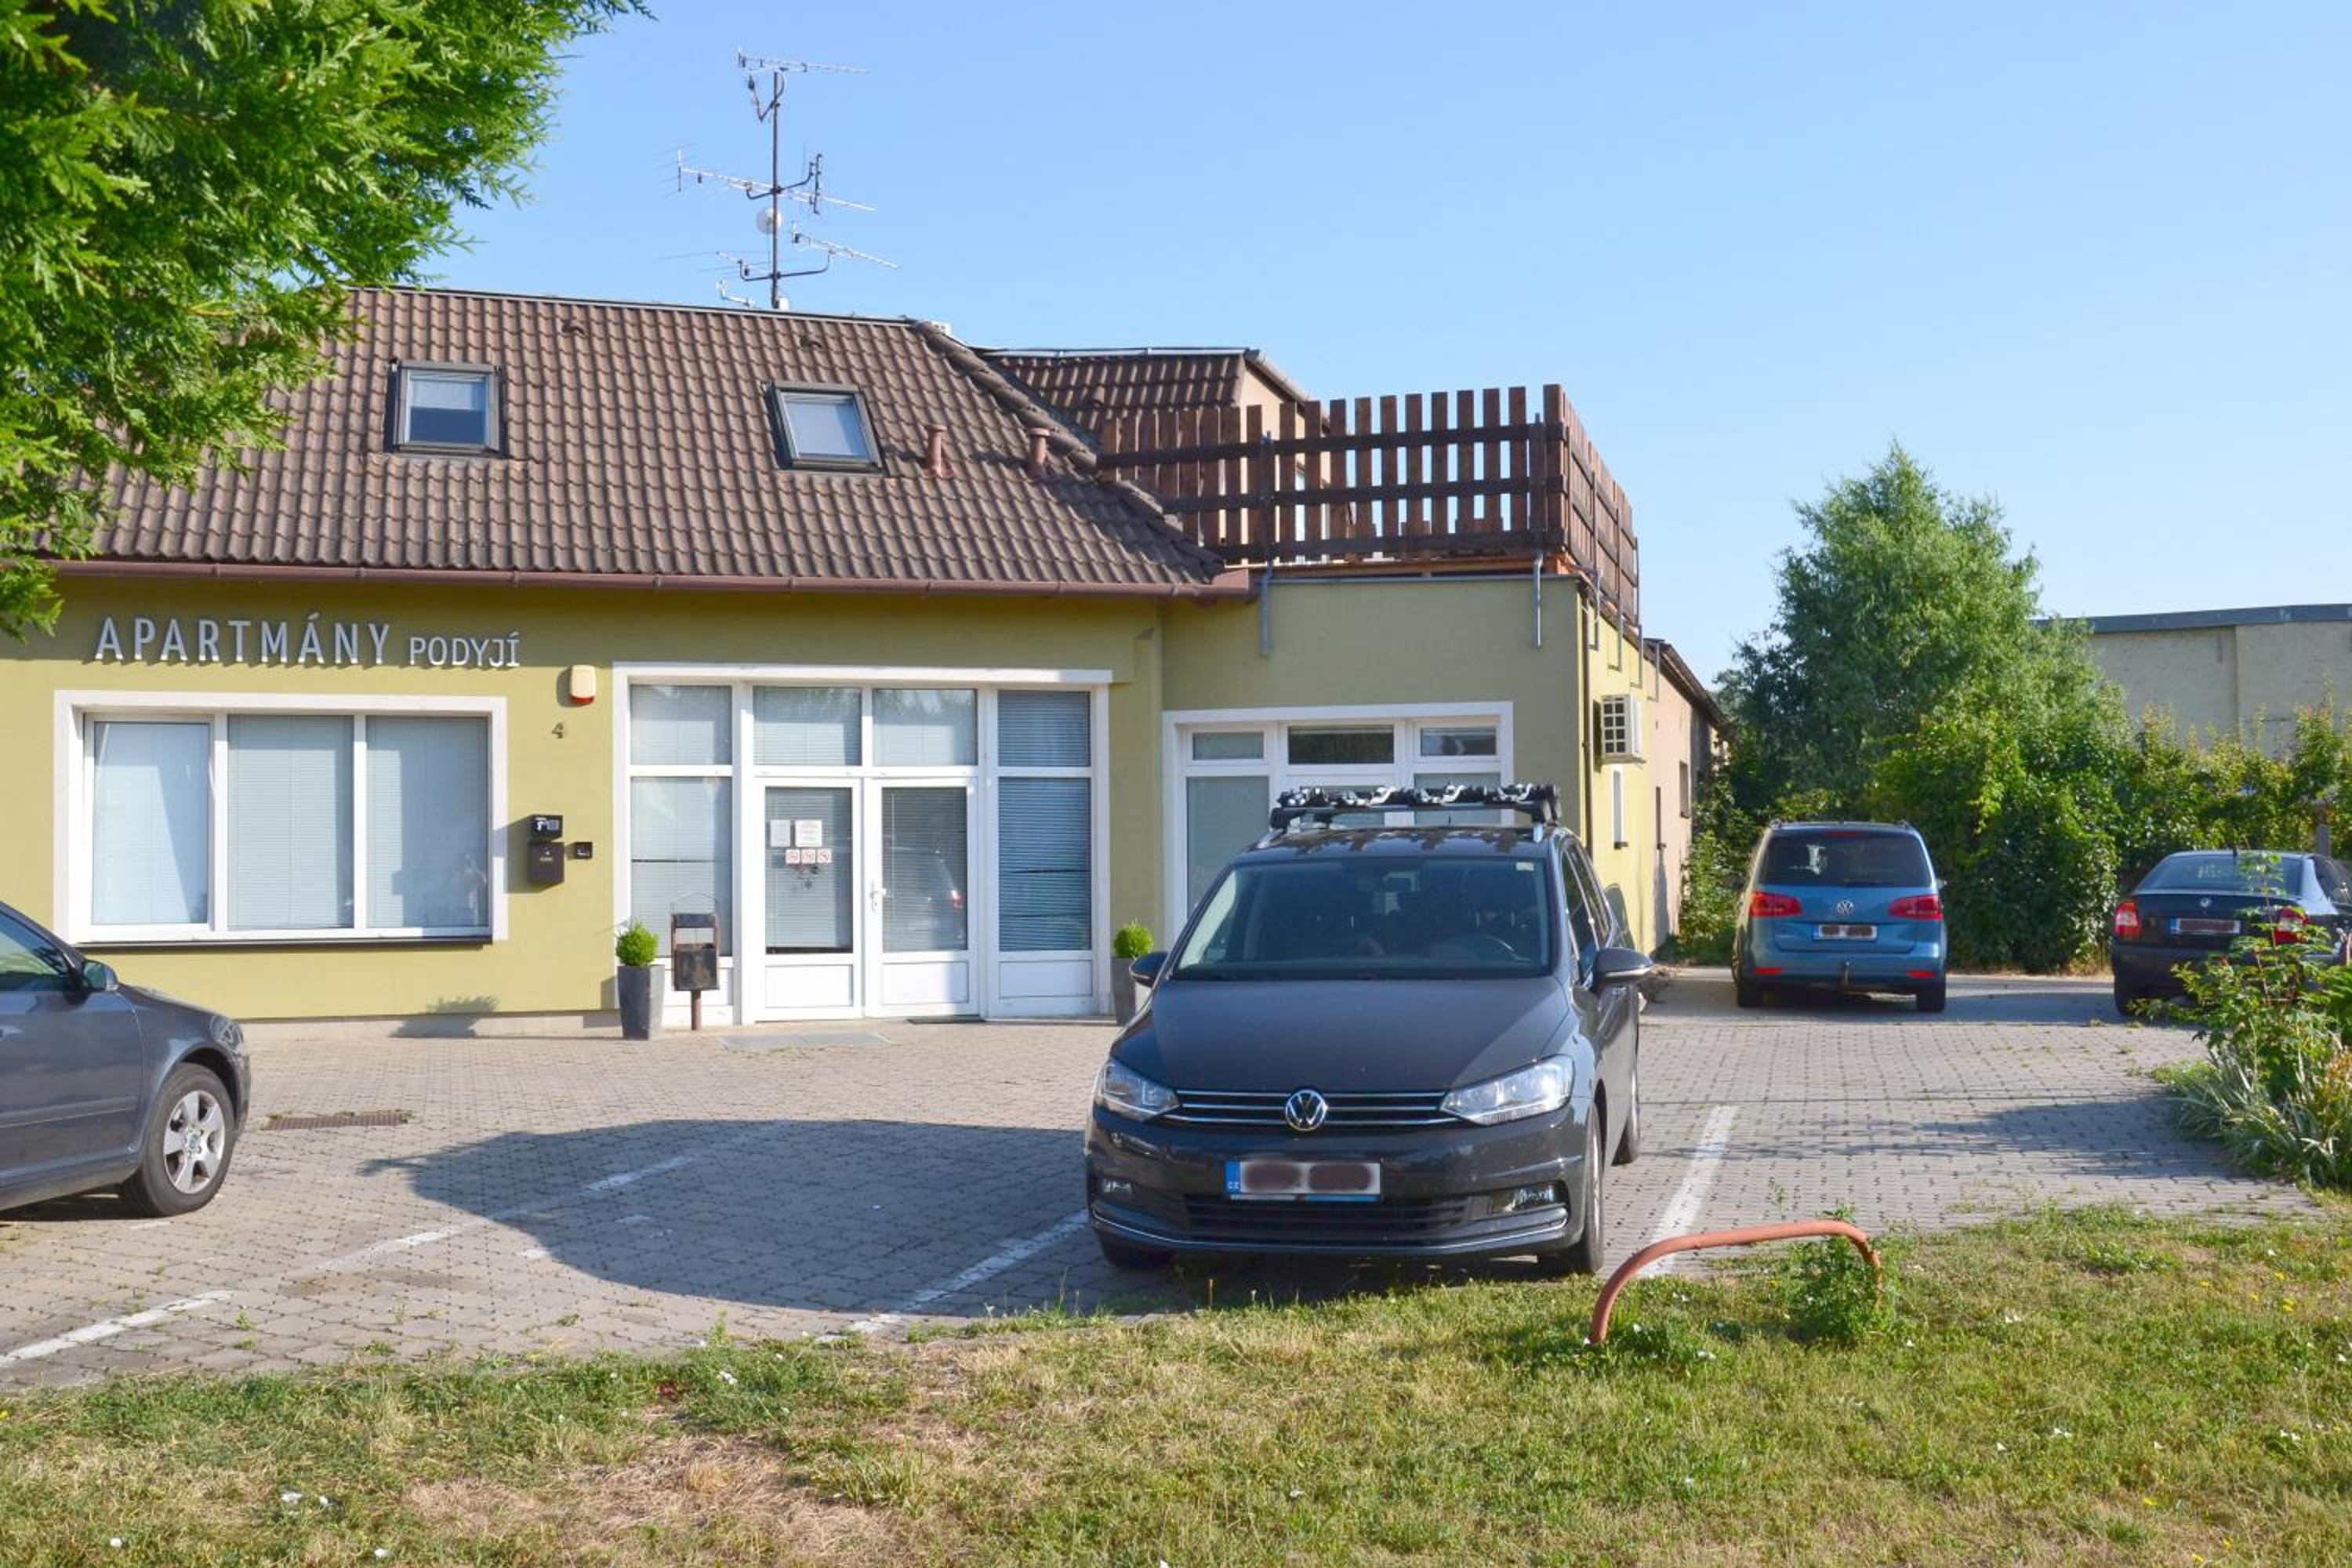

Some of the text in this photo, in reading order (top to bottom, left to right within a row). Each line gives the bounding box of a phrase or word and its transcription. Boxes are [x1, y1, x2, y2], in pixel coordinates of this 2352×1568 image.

[95, 612, 521, 667] APARTMÁNY PODYJÍ
[551, 722, 564, 739] 4
